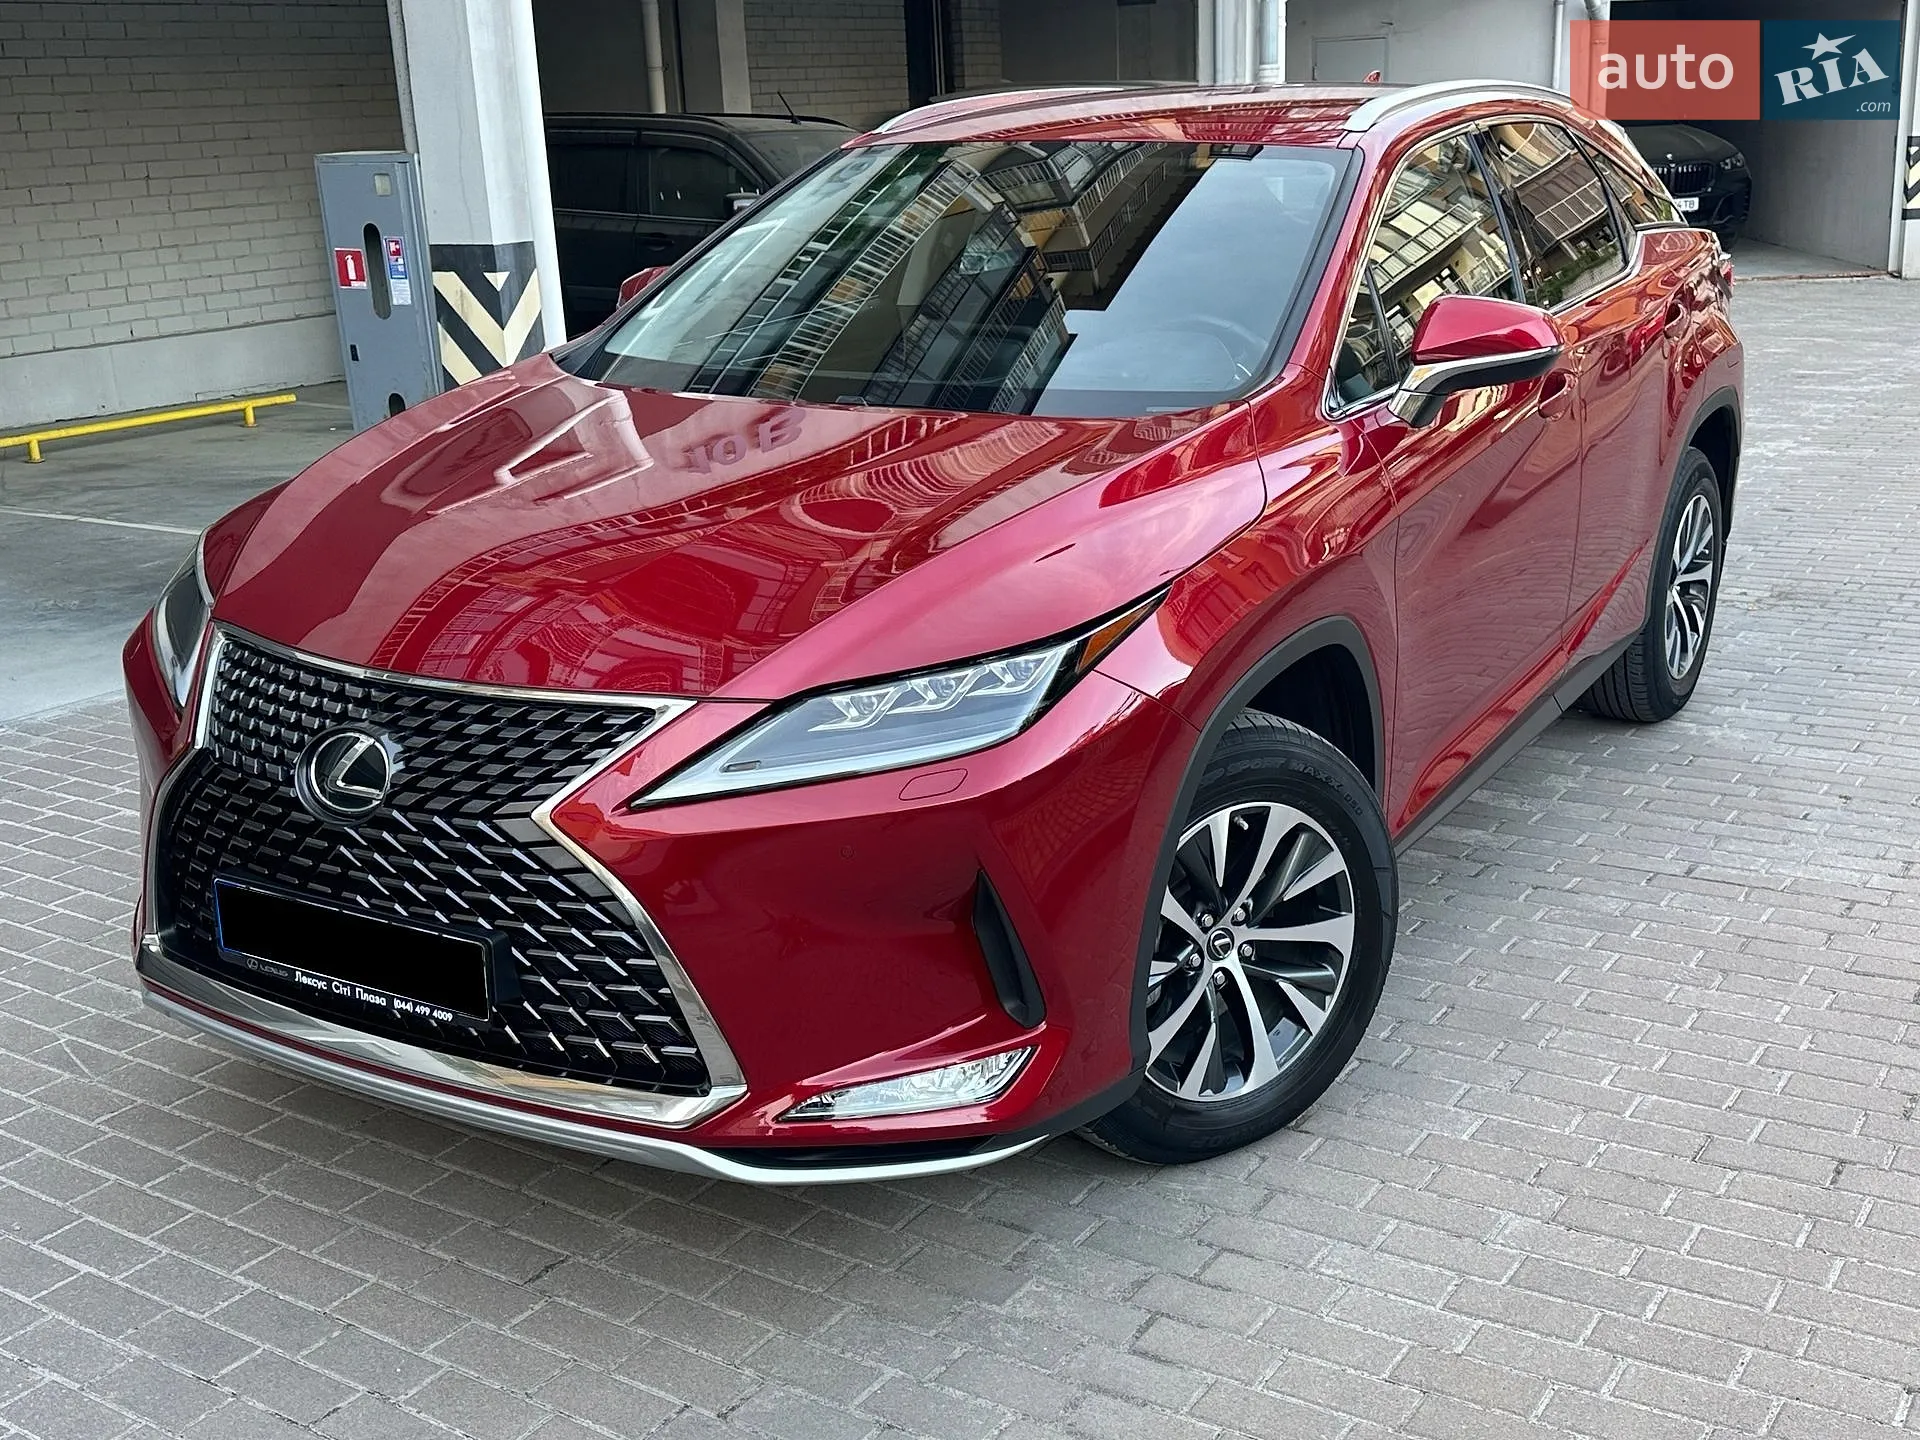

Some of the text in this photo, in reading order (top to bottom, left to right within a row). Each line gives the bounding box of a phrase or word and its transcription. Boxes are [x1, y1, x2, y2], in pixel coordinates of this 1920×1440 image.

[1226, 757, 1287, 776] SPORT
[1288, 760, 1344, 792] MAXX
[294, 970, 328, 990] Лексус
[355, 987, 387, 1006] Плаза
[393, 997, 413, 1013] (044)
[414, 1003, 431, 1017] 499
[432, 1008, 454, 1022] 4009
